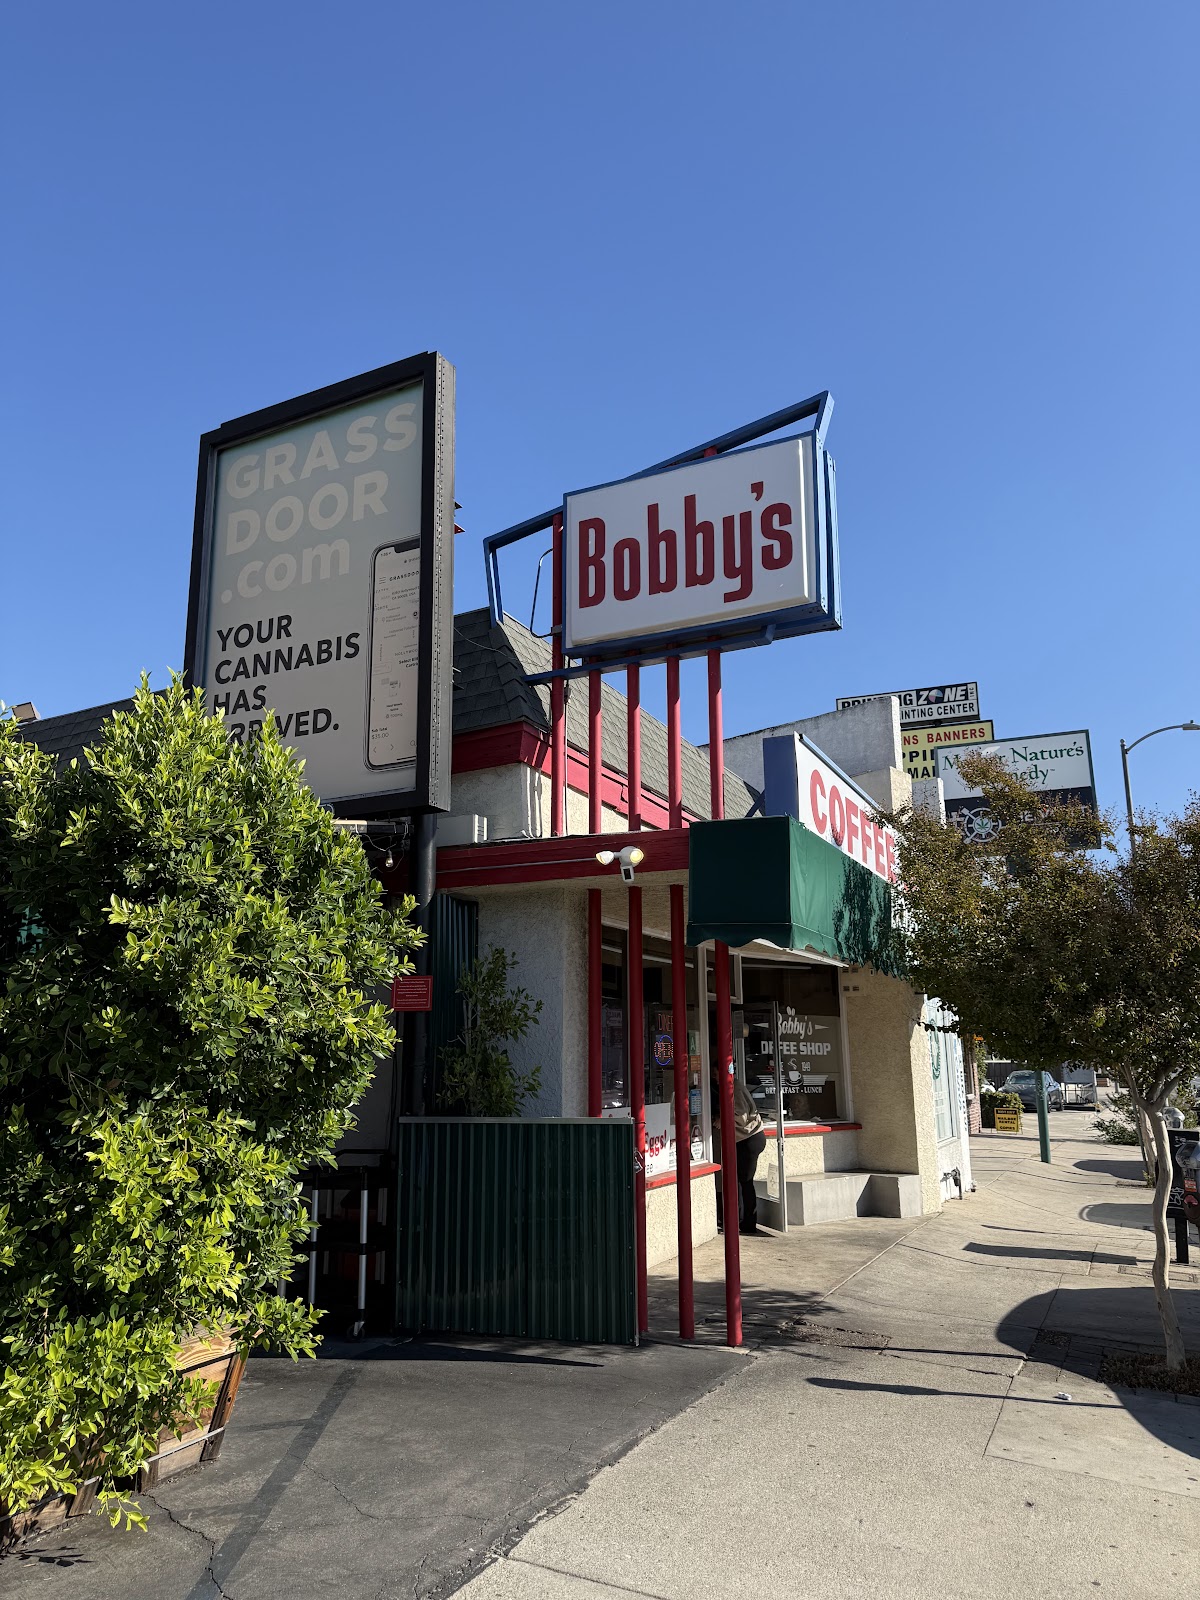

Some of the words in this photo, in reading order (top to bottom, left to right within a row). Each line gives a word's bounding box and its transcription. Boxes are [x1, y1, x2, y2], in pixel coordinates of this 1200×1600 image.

[226, 403, 417, 499] GRASS
[226, 470, 389, 556] DOOR
[578, 481, 793, 609] Bobby's
[221, 538, 350, 604] .com
[216, 614, 292, 652] YOUR
[214, 632, 360, 685] CANNABIS
[213, 684, 267, 716] HAS
[901, 707, 934, 720] INTING
[936, 702, 975, 716] CENTER
[228, 707, 339, 746] RRVED.
[903, 734, 919, 746] NS
[927, 727, 986, 743] BANNERS
[1009, 741, 1084, 764] Nature's
[809, 769, 897, 884] COFFEE
[799, 1042, 831, 1056] SHOP
[804, 1086, 823, 1094] LUNCH
